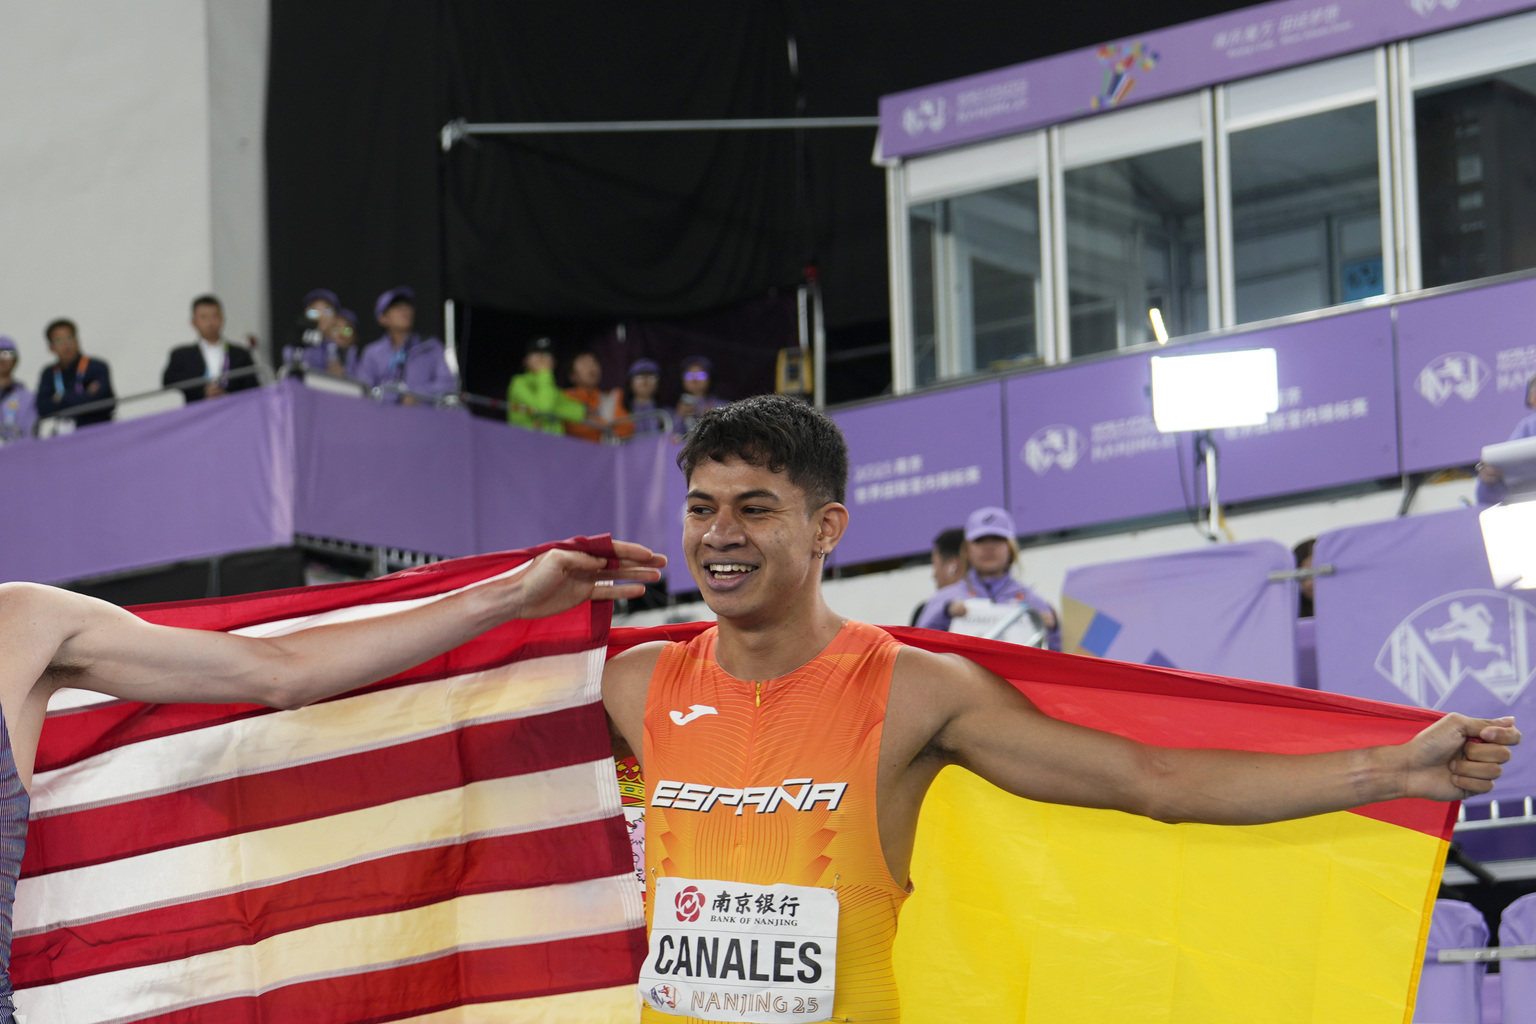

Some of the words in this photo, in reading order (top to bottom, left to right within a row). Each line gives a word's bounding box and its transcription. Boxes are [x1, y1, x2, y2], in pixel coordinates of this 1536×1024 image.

[650, 777, 849, 817] ESPAÑA
[711, 890, 800, 918] 南京银行
[710, 914, 737, 924] BANK
[739, 916, 752, 925] OF
[754, 917, 798, 927] NANJING
[654, 934, 822, 984] CANALES
[690, 990, 788, 1016] NANJING
[792, 996, 819, 1014] 25
